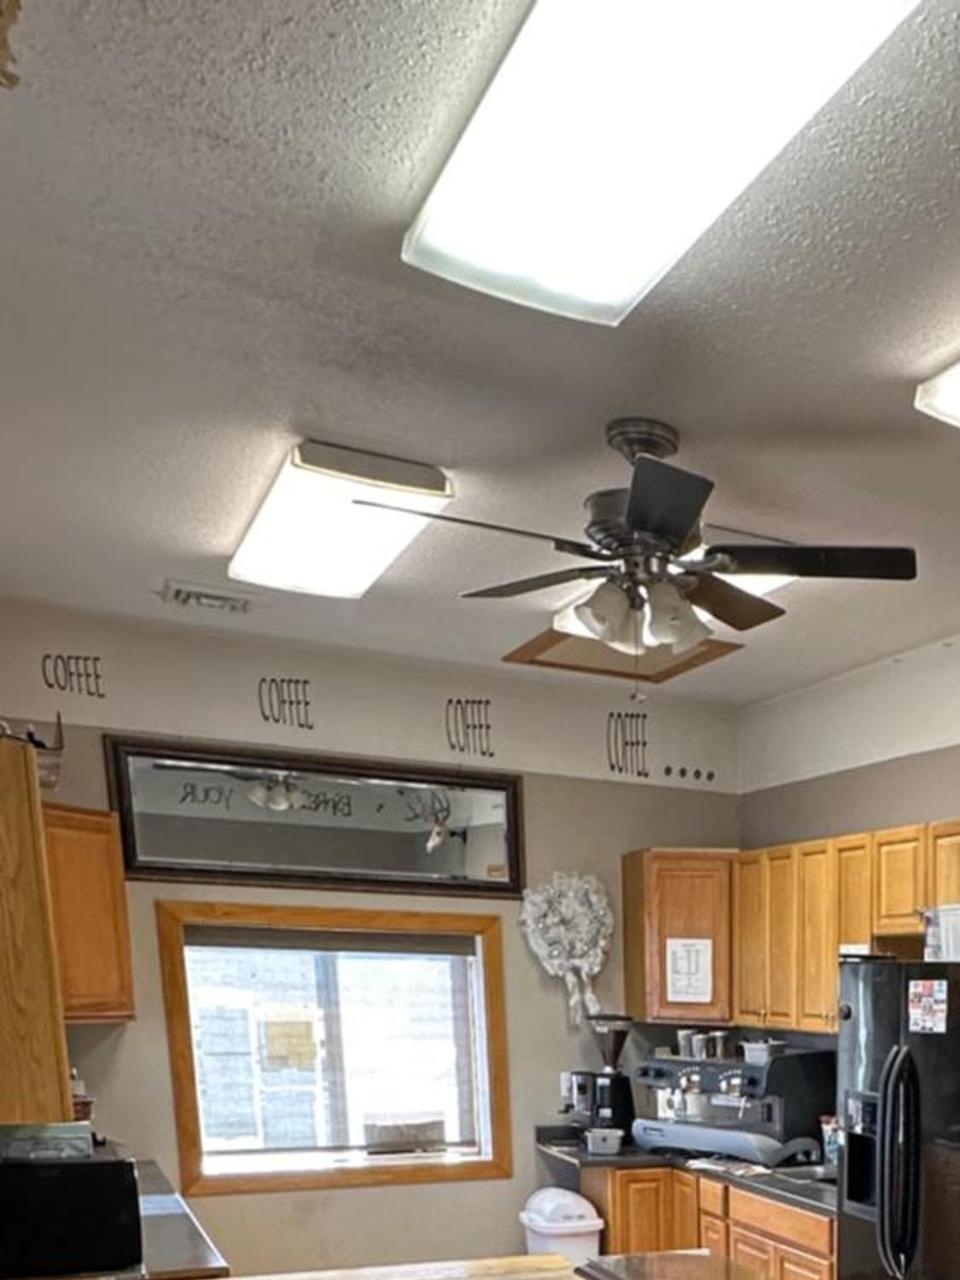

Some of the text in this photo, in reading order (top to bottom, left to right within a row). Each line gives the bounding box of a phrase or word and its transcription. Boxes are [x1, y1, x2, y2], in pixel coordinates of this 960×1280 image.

[41, 653, 106, 699] COFFEE
[258, 677, 314, 731] COFFEE
[445, 698, 495, 759] COFFEE
[607, 711, 650, 779] COFFEE
